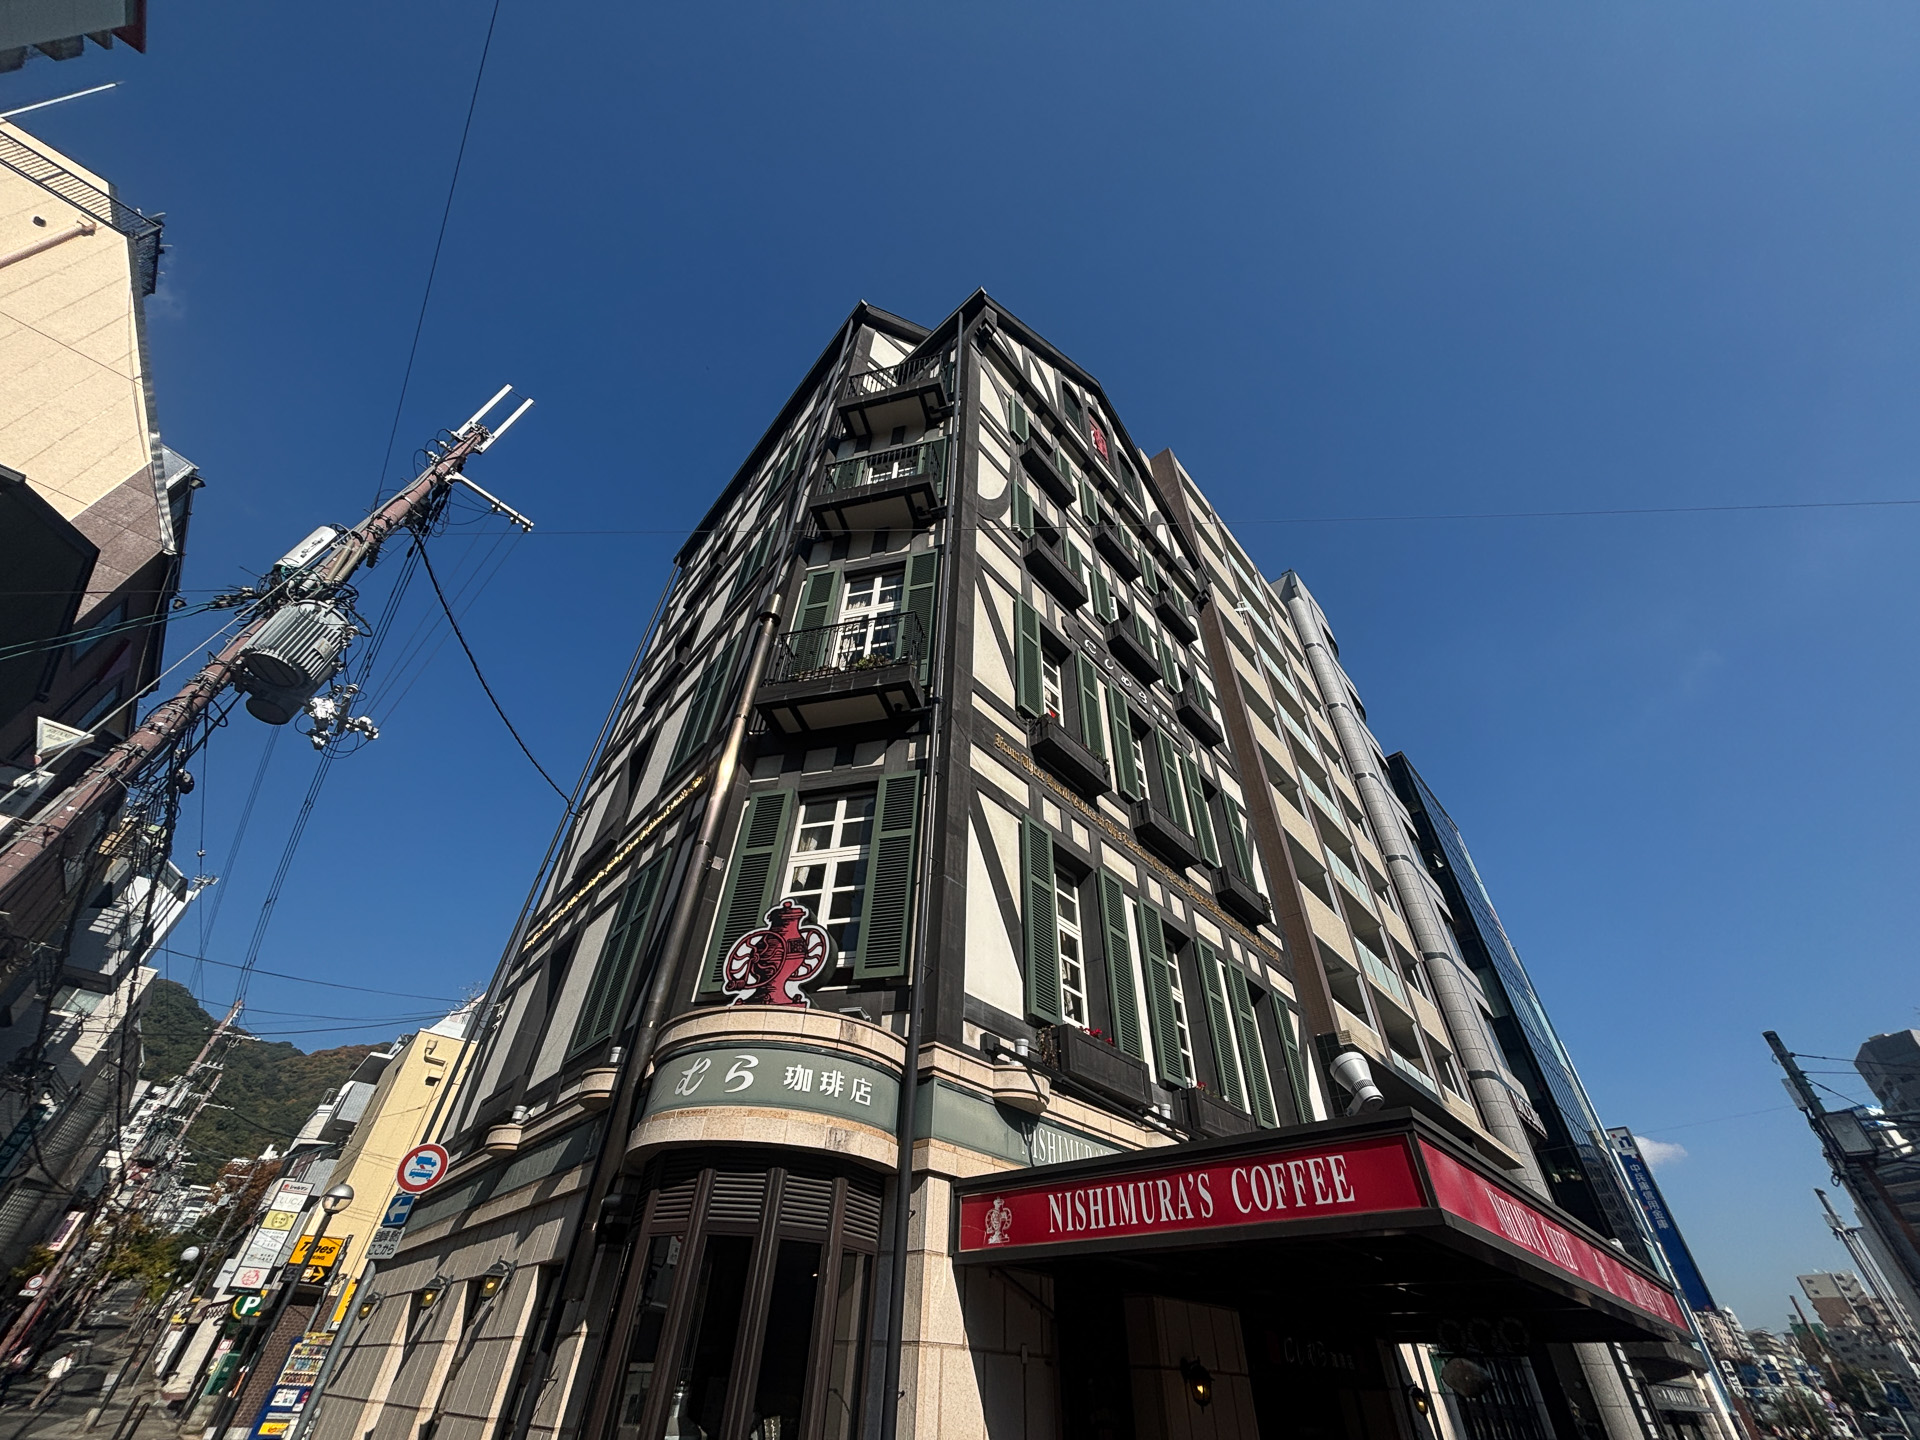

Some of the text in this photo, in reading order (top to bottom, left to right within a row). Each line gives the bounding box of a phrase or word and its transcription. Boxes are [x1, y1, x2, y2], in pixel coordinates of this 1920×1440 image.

[994, 733, 1020, 762] From
[1048, 1154, 1355, 1233] NISHIMURA'S COFFEE
[367, 1244, 395, 1255] ここから
[240, 1296, 261, 1315] P
